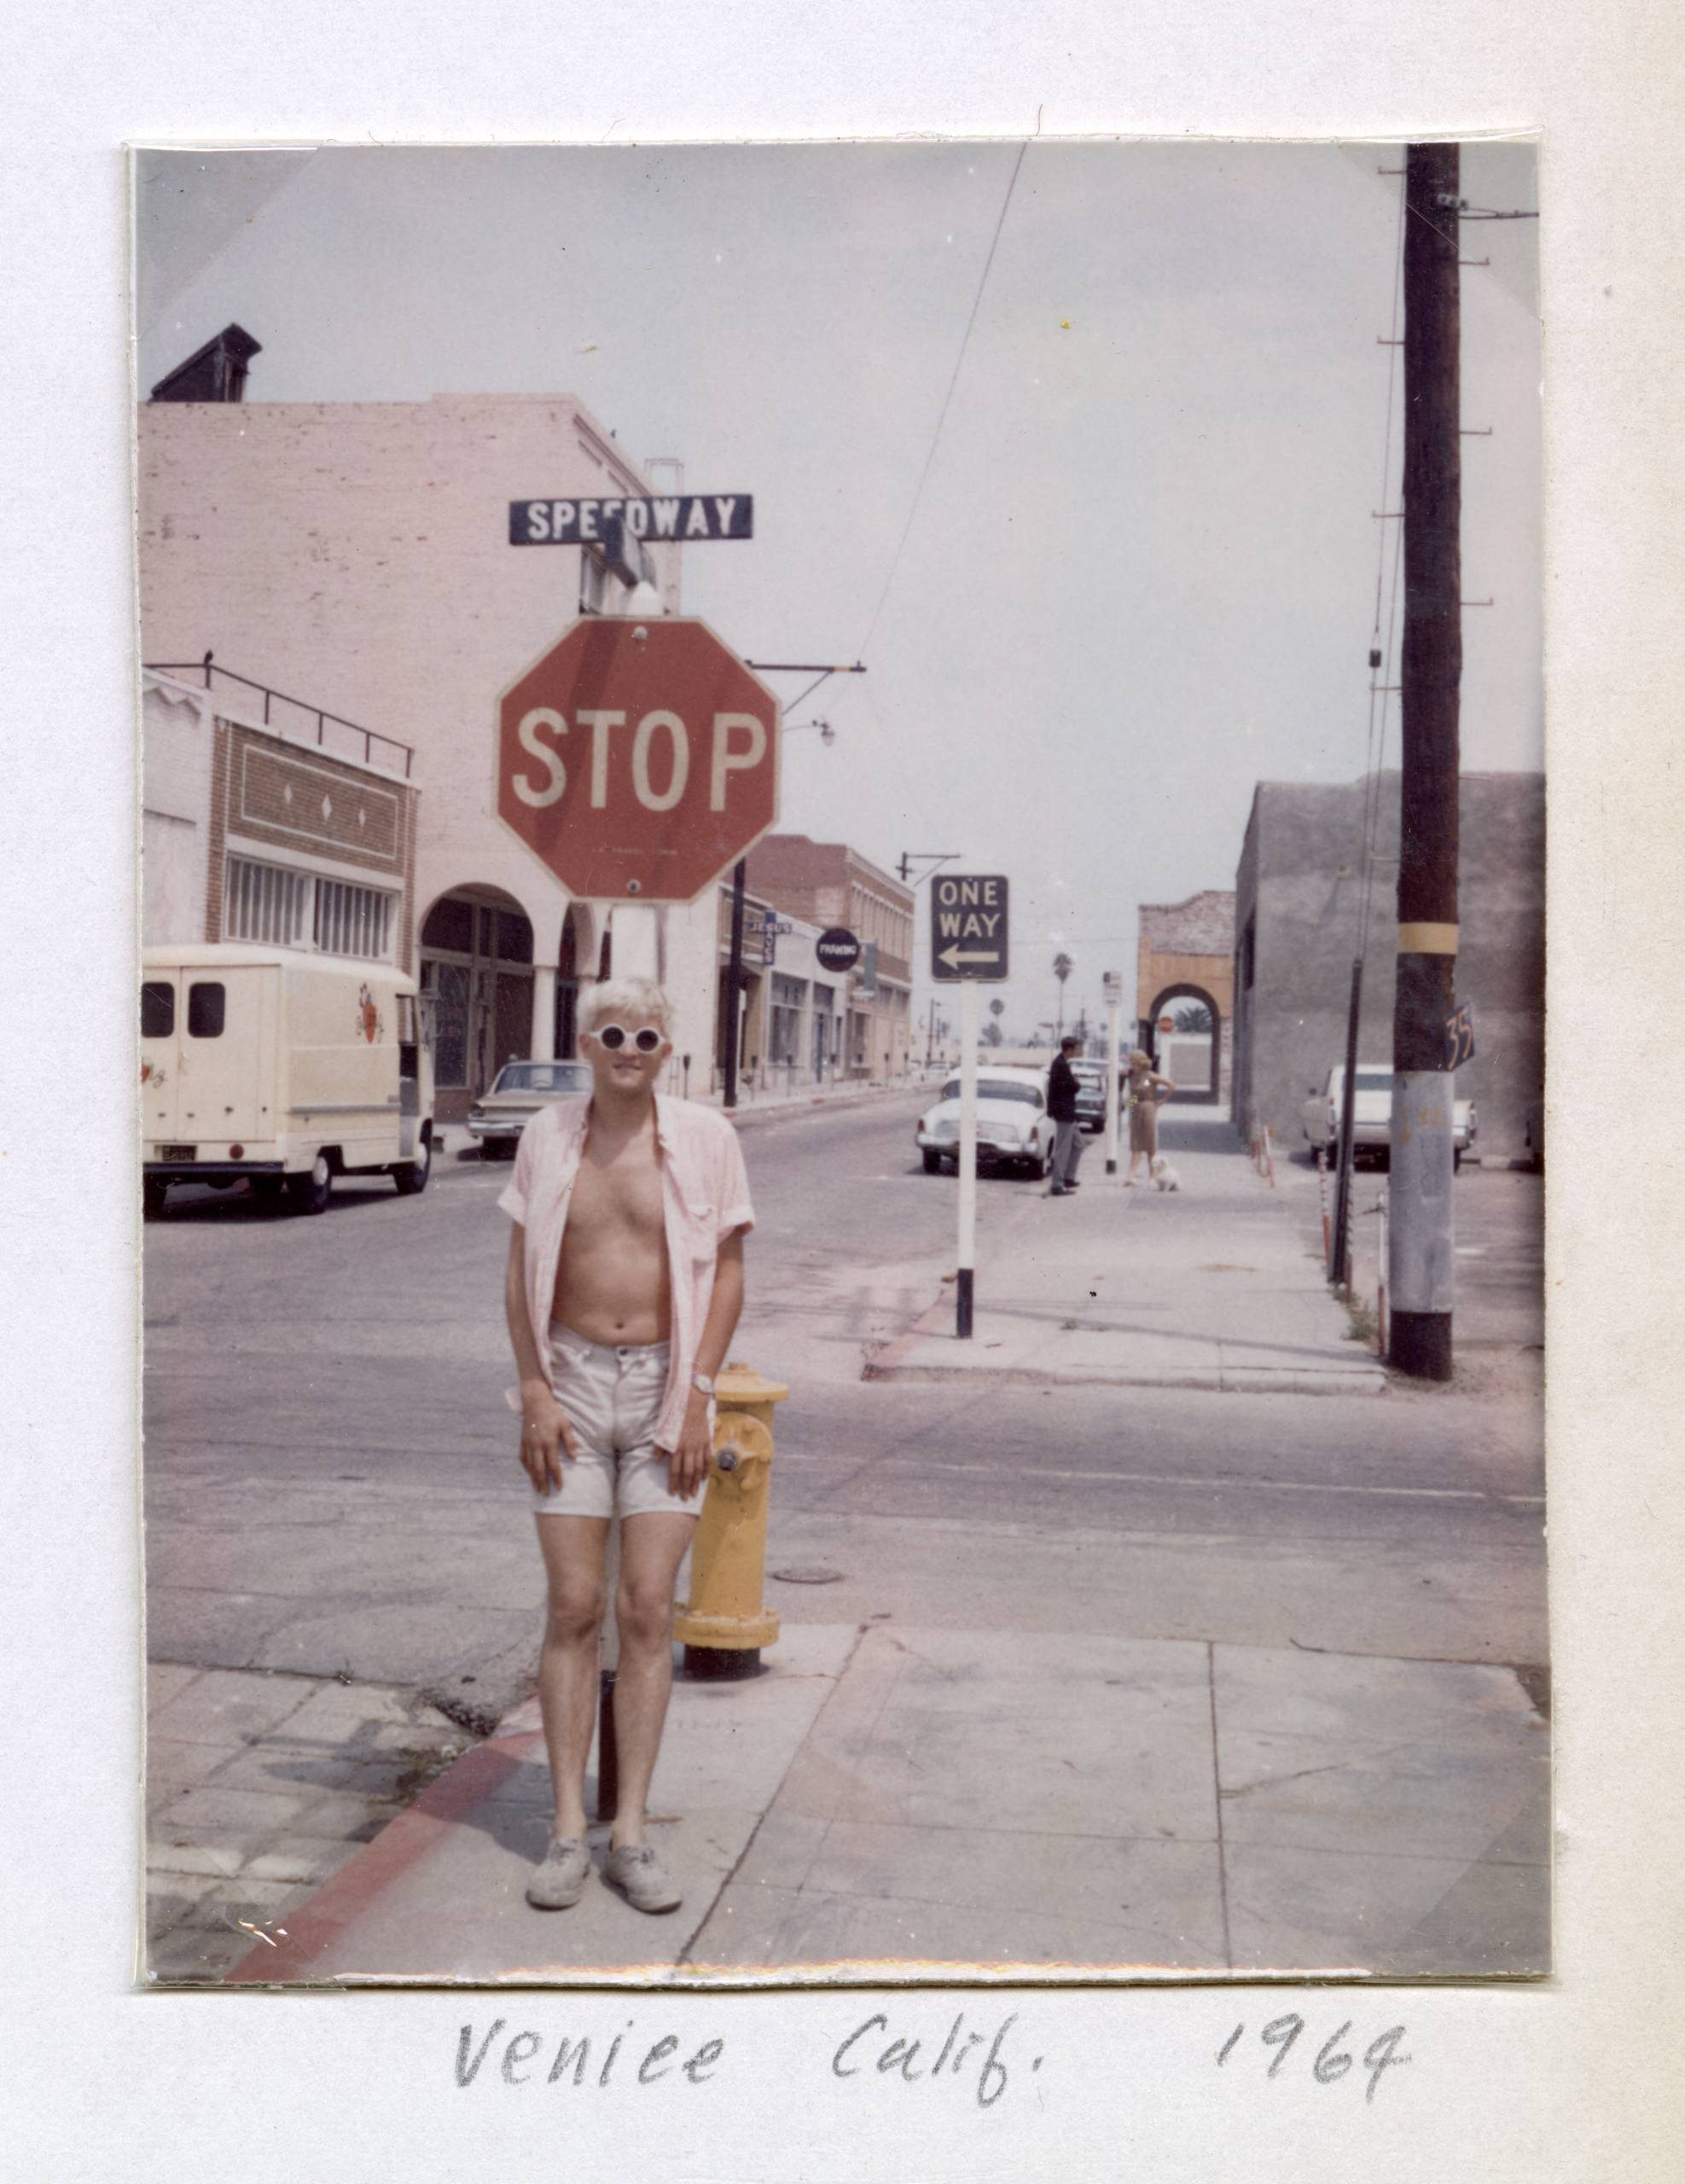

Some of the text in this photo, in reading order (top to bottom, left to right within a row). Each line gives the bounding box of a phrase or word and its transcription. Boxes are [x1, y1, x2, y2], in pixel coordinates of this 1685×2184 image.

[513, 707, 767, 811] STOP
[939, 881, 997, 905] ONE
[750, 922, 792, 933] JESUS
[940, 913, 1001, 938] WAY
[833, 2013, 1043, 2108] Calif.
[1217, 2013, 1413, 2104] 1964
